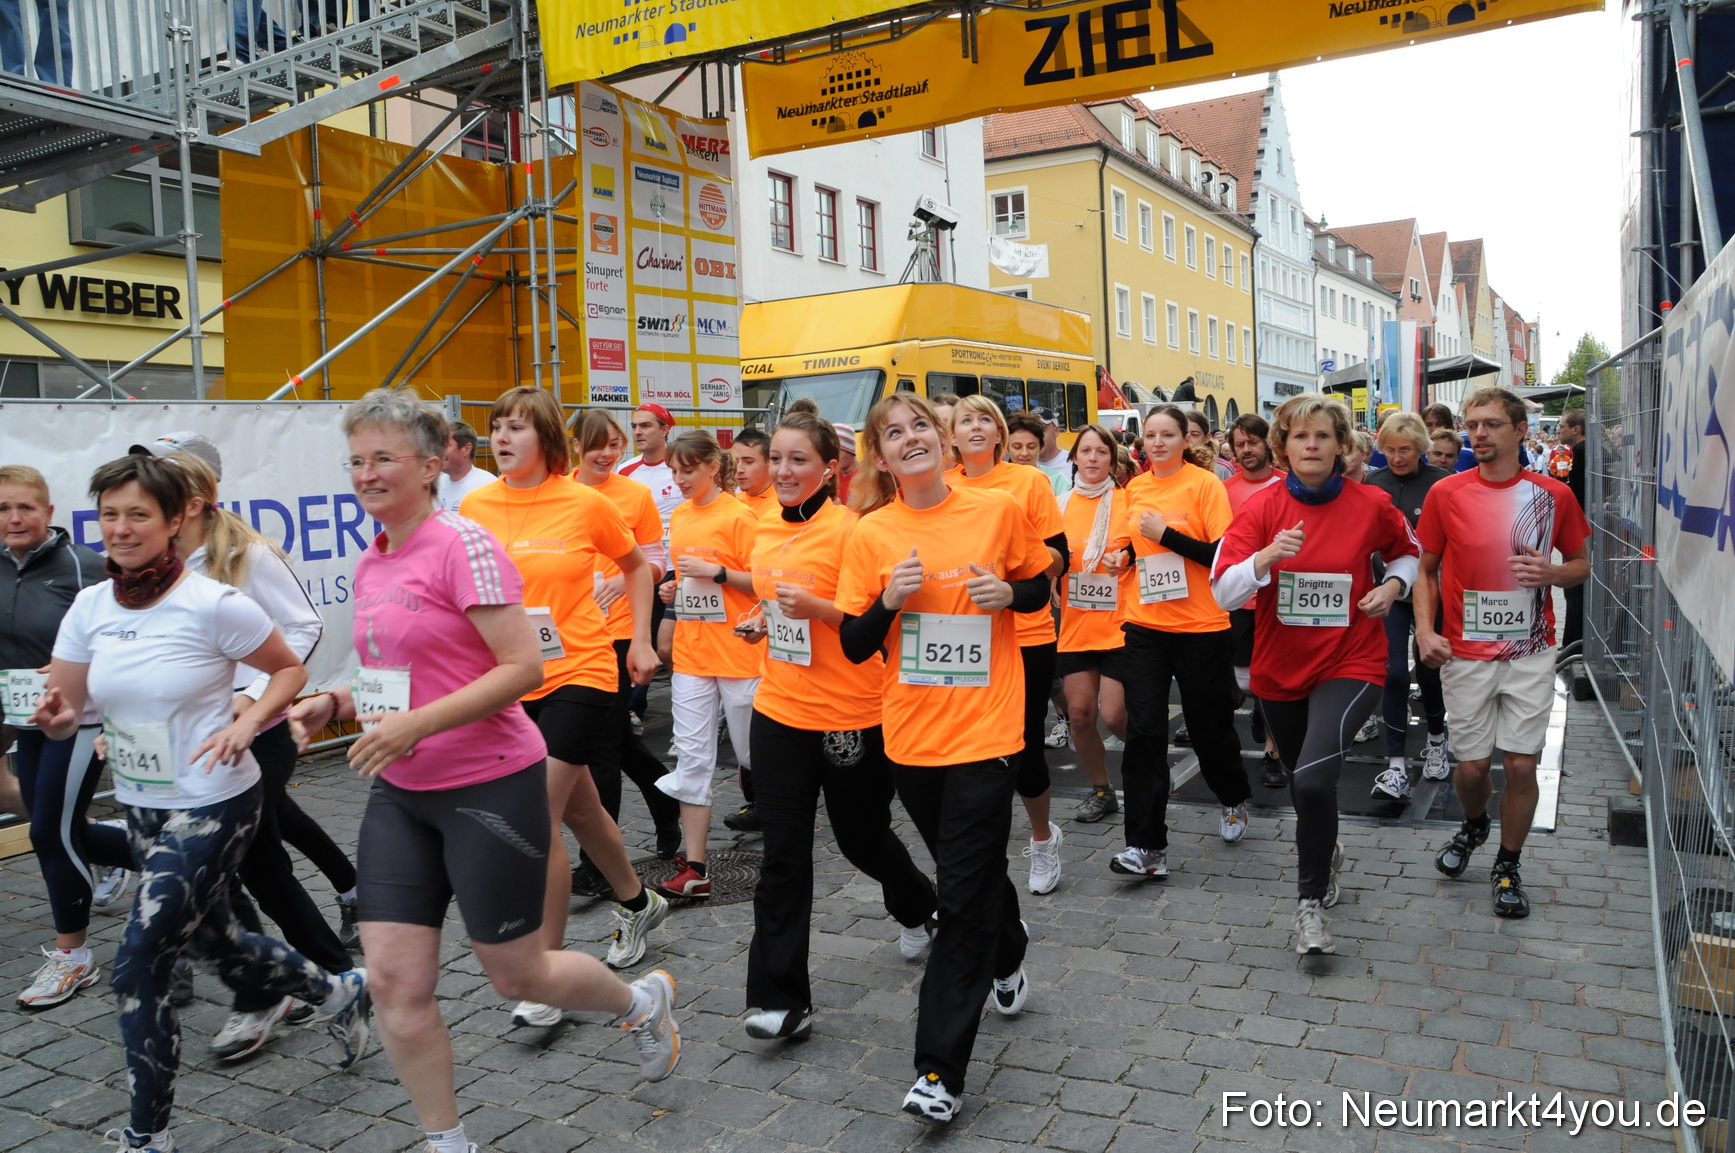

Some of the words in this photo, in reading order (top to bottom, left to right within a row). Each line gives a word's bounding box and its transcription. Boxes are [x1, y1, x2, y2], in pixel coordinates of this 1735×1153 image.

[575, 6, 665, 39] Neumarkter
[669, 0, 738, 15] Stad
[1024, 0, 1214, 86] ZIEL
[776, 94, 858, 119] Neumarkter
[861, 79, 929, 105] Stadtlauf
[582, 128, 605, 138] GERHART
[645, 136, 667, 152] KANN
[681, 134, 730, 155] MERZ
[593, 187, 613, 198] KANN
[698, 203, 727, 215] WITTMANN
[585, 261, 623, 279] Sinupret
[694, 257, 736, 279] OBI
[586, 277, 609, 292] forte
[0, 267, 26, 306] Y
[37, 272, 183, 320] WEBER
[598, 304, 626, 315] Egner
[637, 315, 670, 332] swn
[696, 317, 727, 334] MCM
[602, 340, 612, 349] FÜR
[951, 348, 986, 361] SPORTRONIC
[802, 355, 861, 370] TIMING
[1037, 359, 1051, 370] EVENT
[1052, 360, 1071, 372] SERVICE
[596, 385, 629, 393] INTERSPORT
[656, 390, 672, 398] MAX
[674, 389, 691, 398] BÖGL
[700, 383, 726, 391] GERHART
[712, 390, 730, 398] JANIG
[591, 393, 629, 403] HACKNER
[1150, 570, 1180, 588] 5219
[1298, 577, 1333, 590] Brigitte
[1080, 584, 1112, 598] 5242
[686, 595, 719, 609] 5216
[1298, 593, 1343, 609] 5019
[1481, 596, 1508, 606] Marco
[1483, 610, 1525, 626] 5024
[777, 624, 805, 645] 5214
[925, 642, 982, 664] 5215
[10, 675, 32, 686] Maria
[118, 747, 161, 772] 5141
